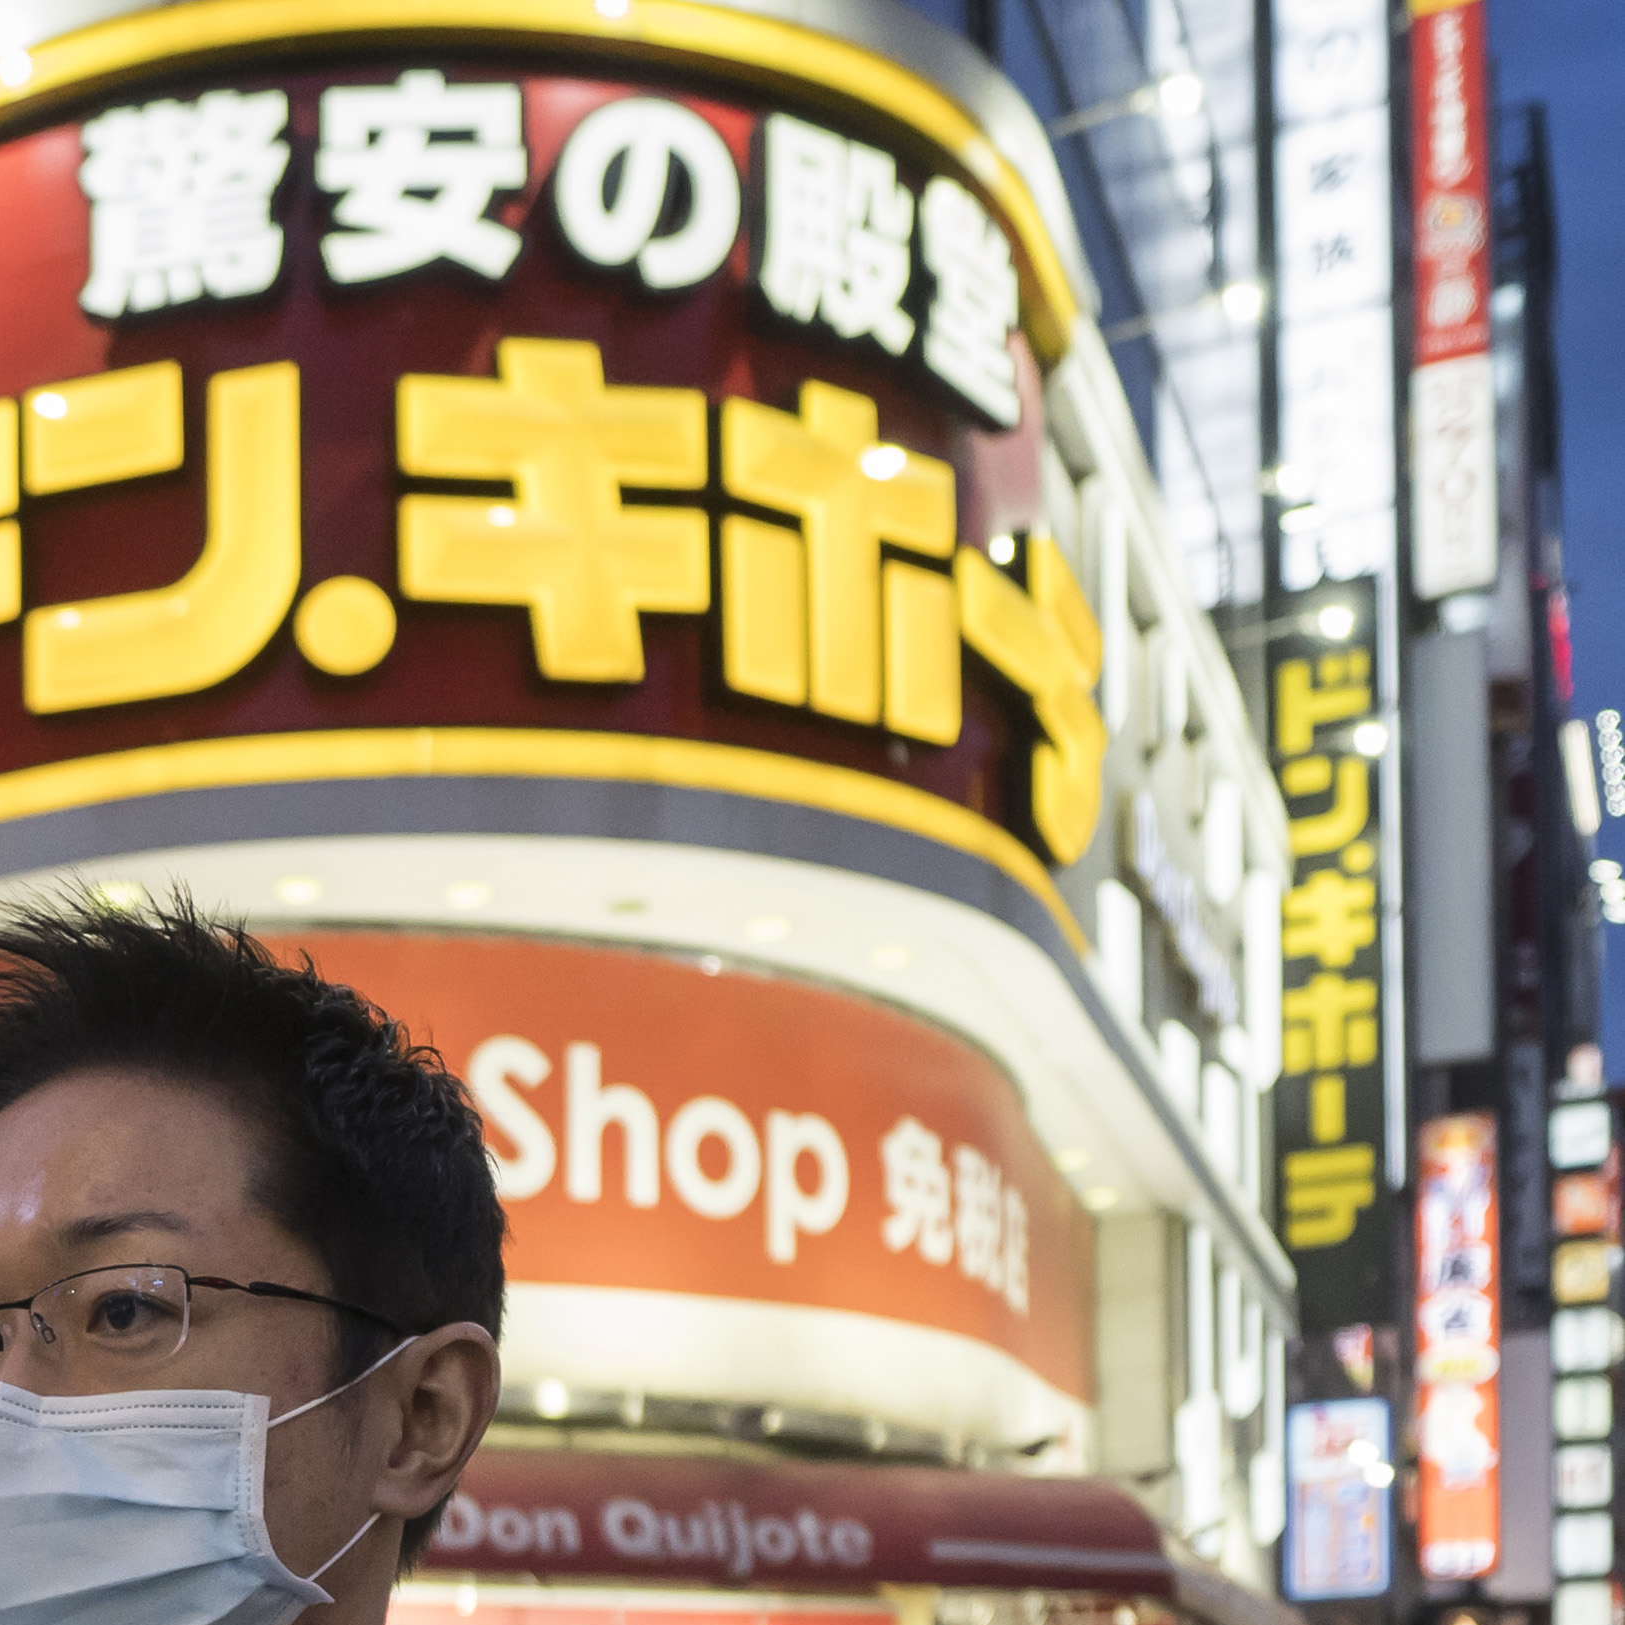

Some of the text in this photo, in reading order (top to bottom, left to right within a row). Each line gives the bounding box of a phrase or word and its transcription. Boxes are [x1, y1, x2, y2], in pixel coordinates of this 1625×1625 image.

[79, 68, 1025, 430] 驚安の殿堂
[467, 1035, 850, 1265] Shop
[435, 1491, 874, 1578] Don Quijote
